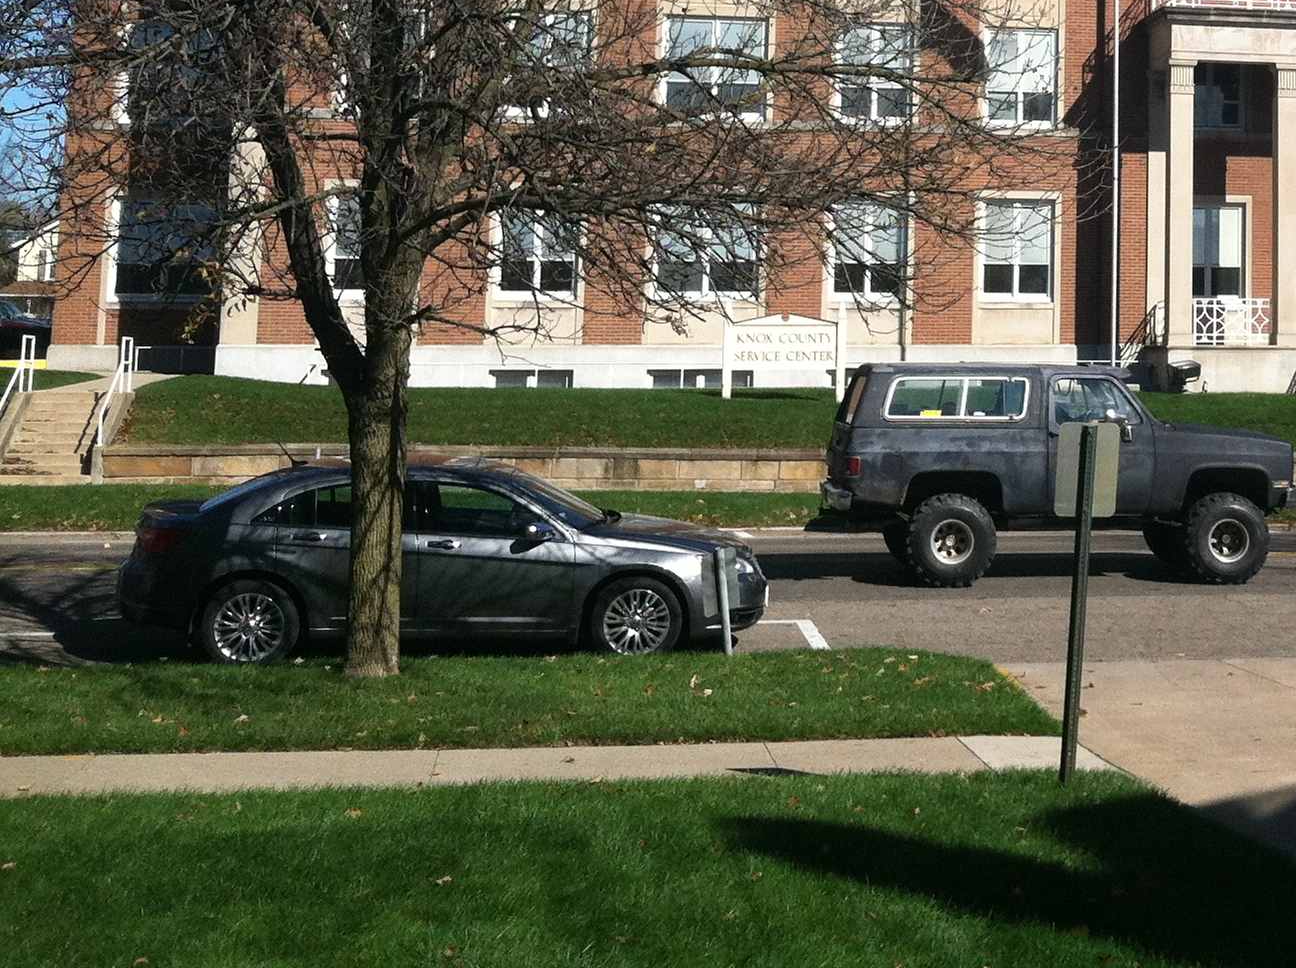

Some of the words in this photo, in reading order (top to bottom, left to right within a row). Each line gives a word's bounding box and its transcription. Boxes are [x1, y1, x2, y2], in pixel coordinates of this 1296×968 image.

[736, 333, 773, 344] KNOX
[779, 333, 831, 344] COUNTY
[734, 351, 780, 361] SERVICE
[786, 351, 834, 361] CENTER
